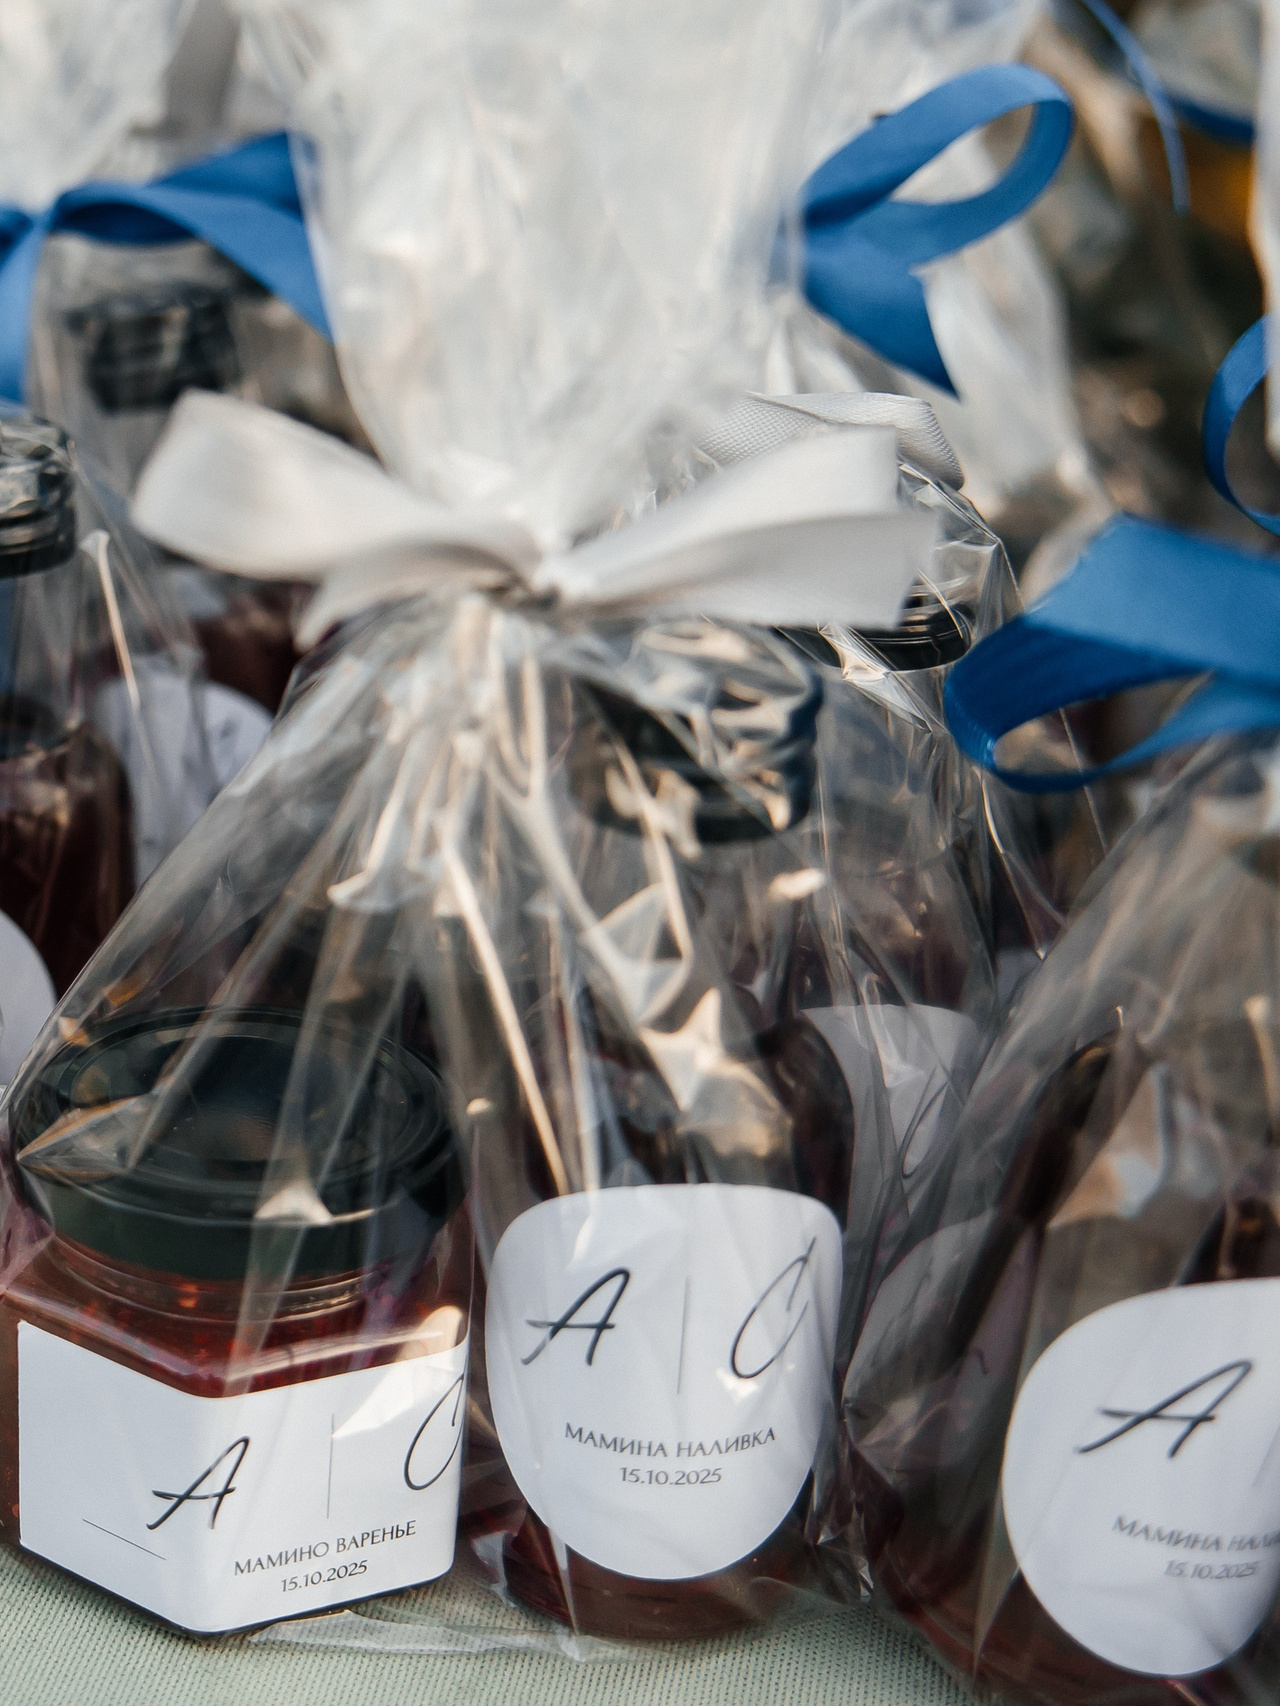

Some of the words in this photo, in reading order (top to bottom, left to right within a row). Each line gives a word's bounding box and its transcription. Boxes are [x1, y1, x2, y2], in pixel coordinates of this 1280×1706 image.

[565, 1422, 668, 1458] МАМИНА
[675, 1427, 776, 1458] НАЛИВКА
[620, 1467, 723, 1486] 15.10.2025
[234, 1541, 330, 1577] МАМИНО
[336, 1519, 417, 1554] ВАРЕНЬЕ
[1112, 1515, 1221, 1551] МАМИНА
[281, 1559, 369, 1593] 15.10.2025
[1164, 1560, 1259, 1580] 15.10.2025
